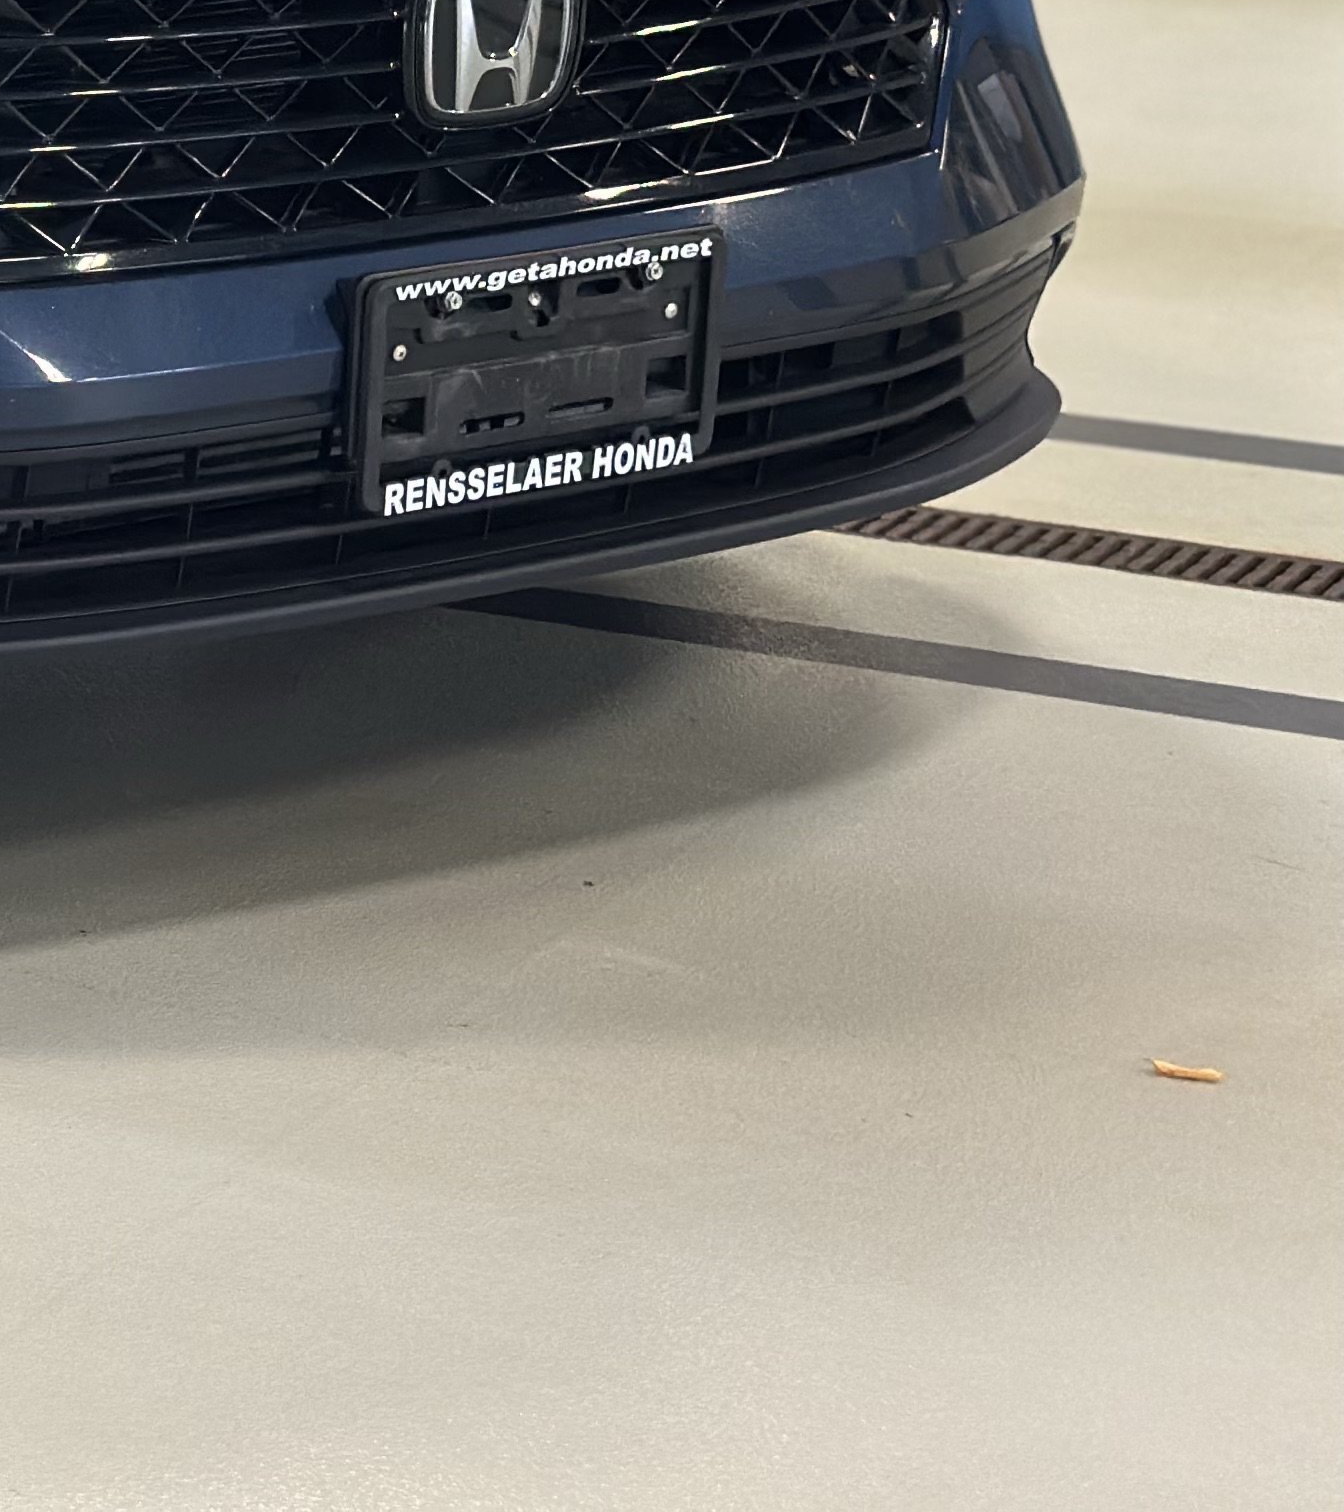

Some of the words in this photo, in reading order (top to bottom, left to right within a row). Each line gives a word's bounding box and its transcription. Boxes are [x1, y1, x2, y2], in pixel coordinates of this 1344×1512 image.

[395, 237, 713, 302] www.getahonda.net
[383, 451, 584, 517] RENSSELAER
[591, 432, 694, 480] HONDA
